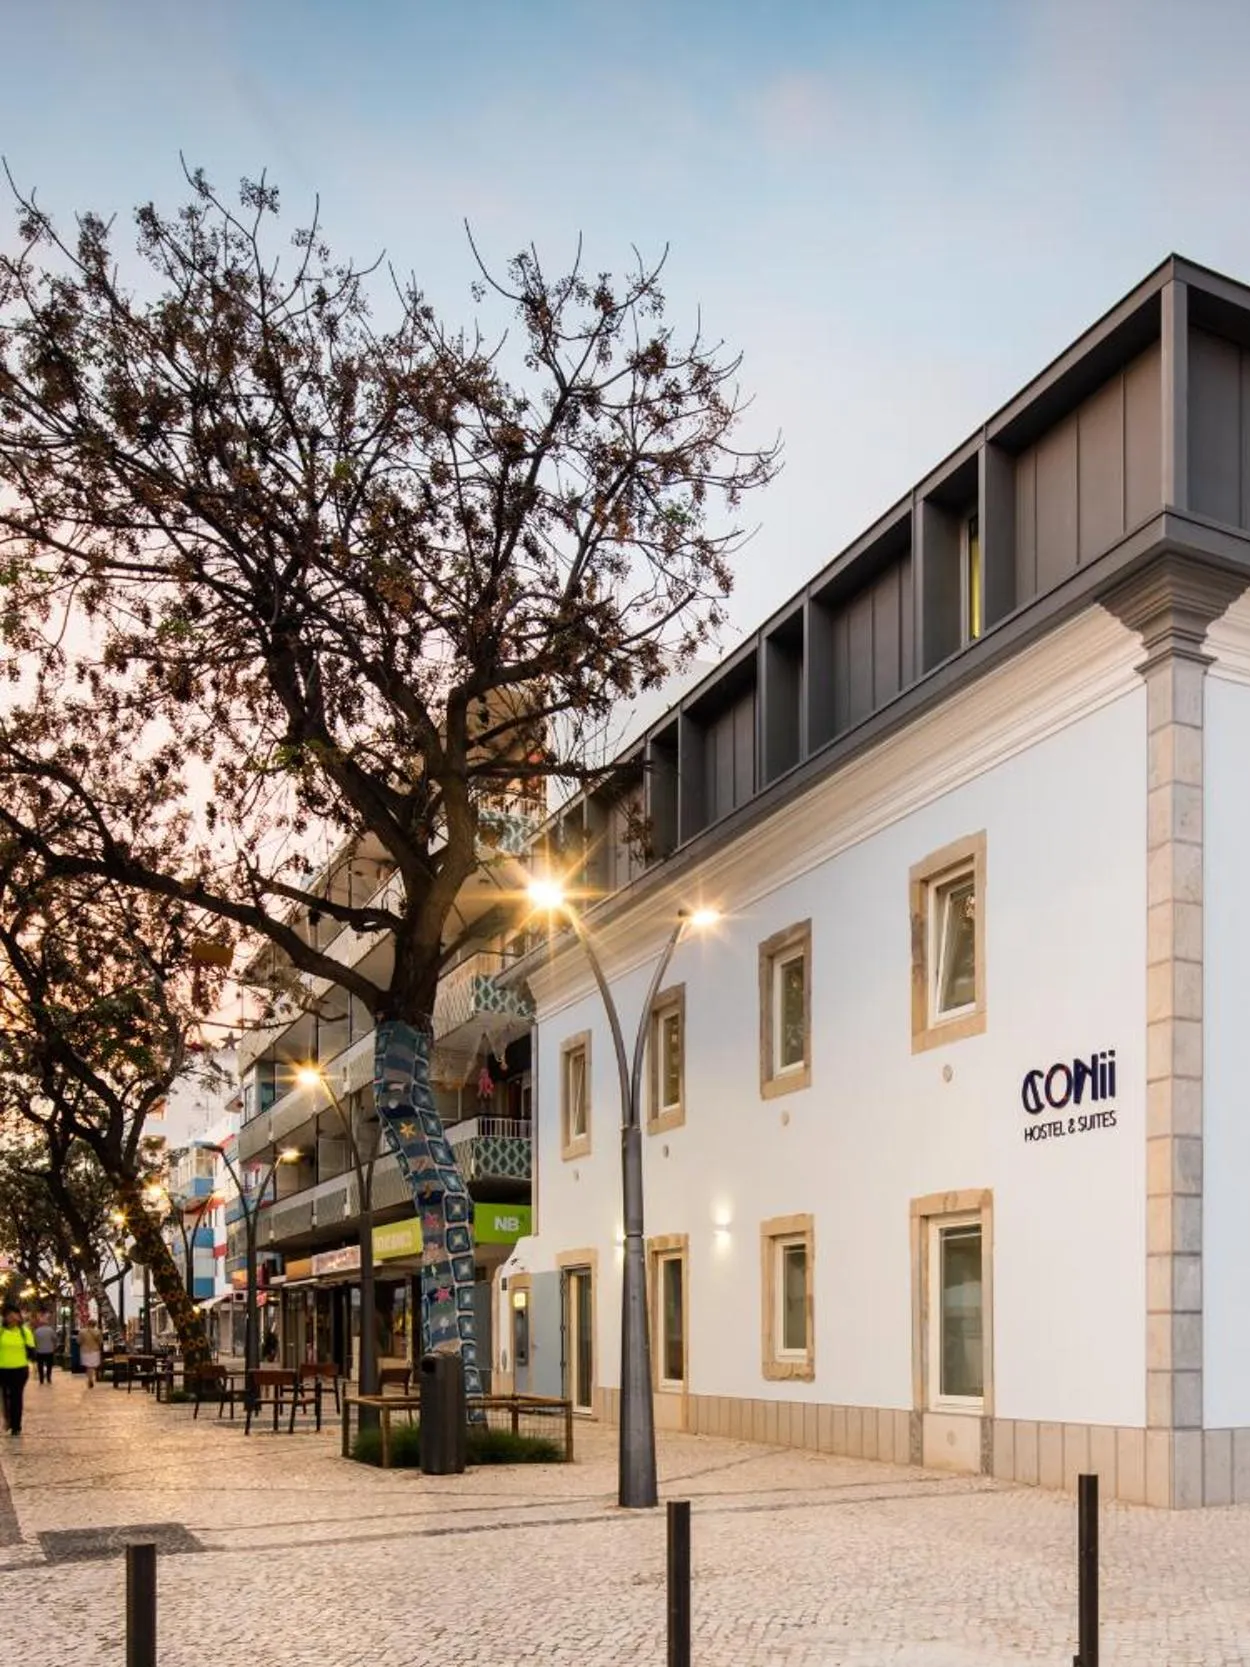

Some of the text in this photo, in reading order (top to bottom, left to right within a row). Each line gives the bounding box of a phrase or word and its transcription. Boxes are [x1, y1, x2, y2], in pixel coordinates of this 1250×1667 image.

[1024, 1110, 1118, 1142] HOSTEL & SUITES
[494, 1215, 520, 1231] NB
